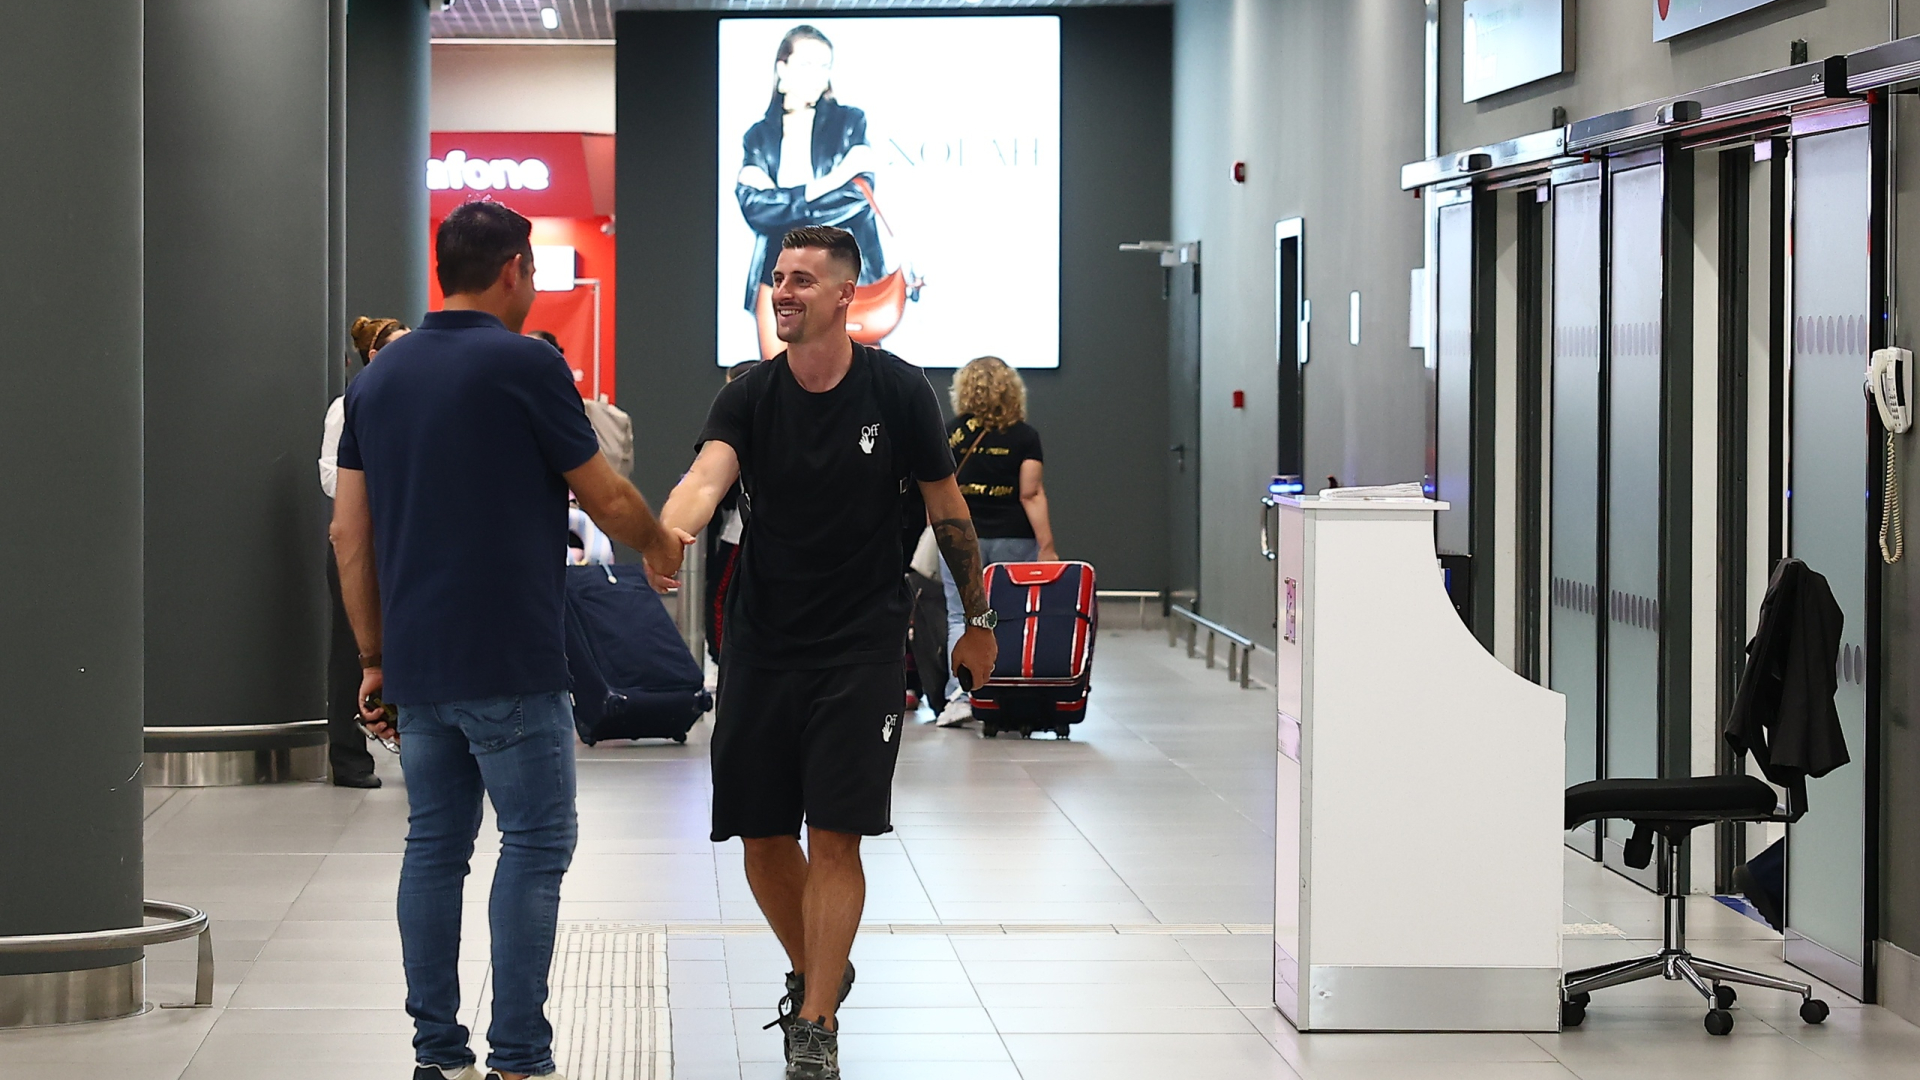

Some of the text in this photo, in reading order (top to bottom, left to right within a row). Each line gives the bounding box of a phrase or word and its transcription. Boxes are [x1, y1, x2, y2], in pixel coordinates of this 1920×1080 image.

[888, 138, 1038, 166] NOAH
[861, 423, 880, 437] Off
[884, 714, 898, 726] Off
